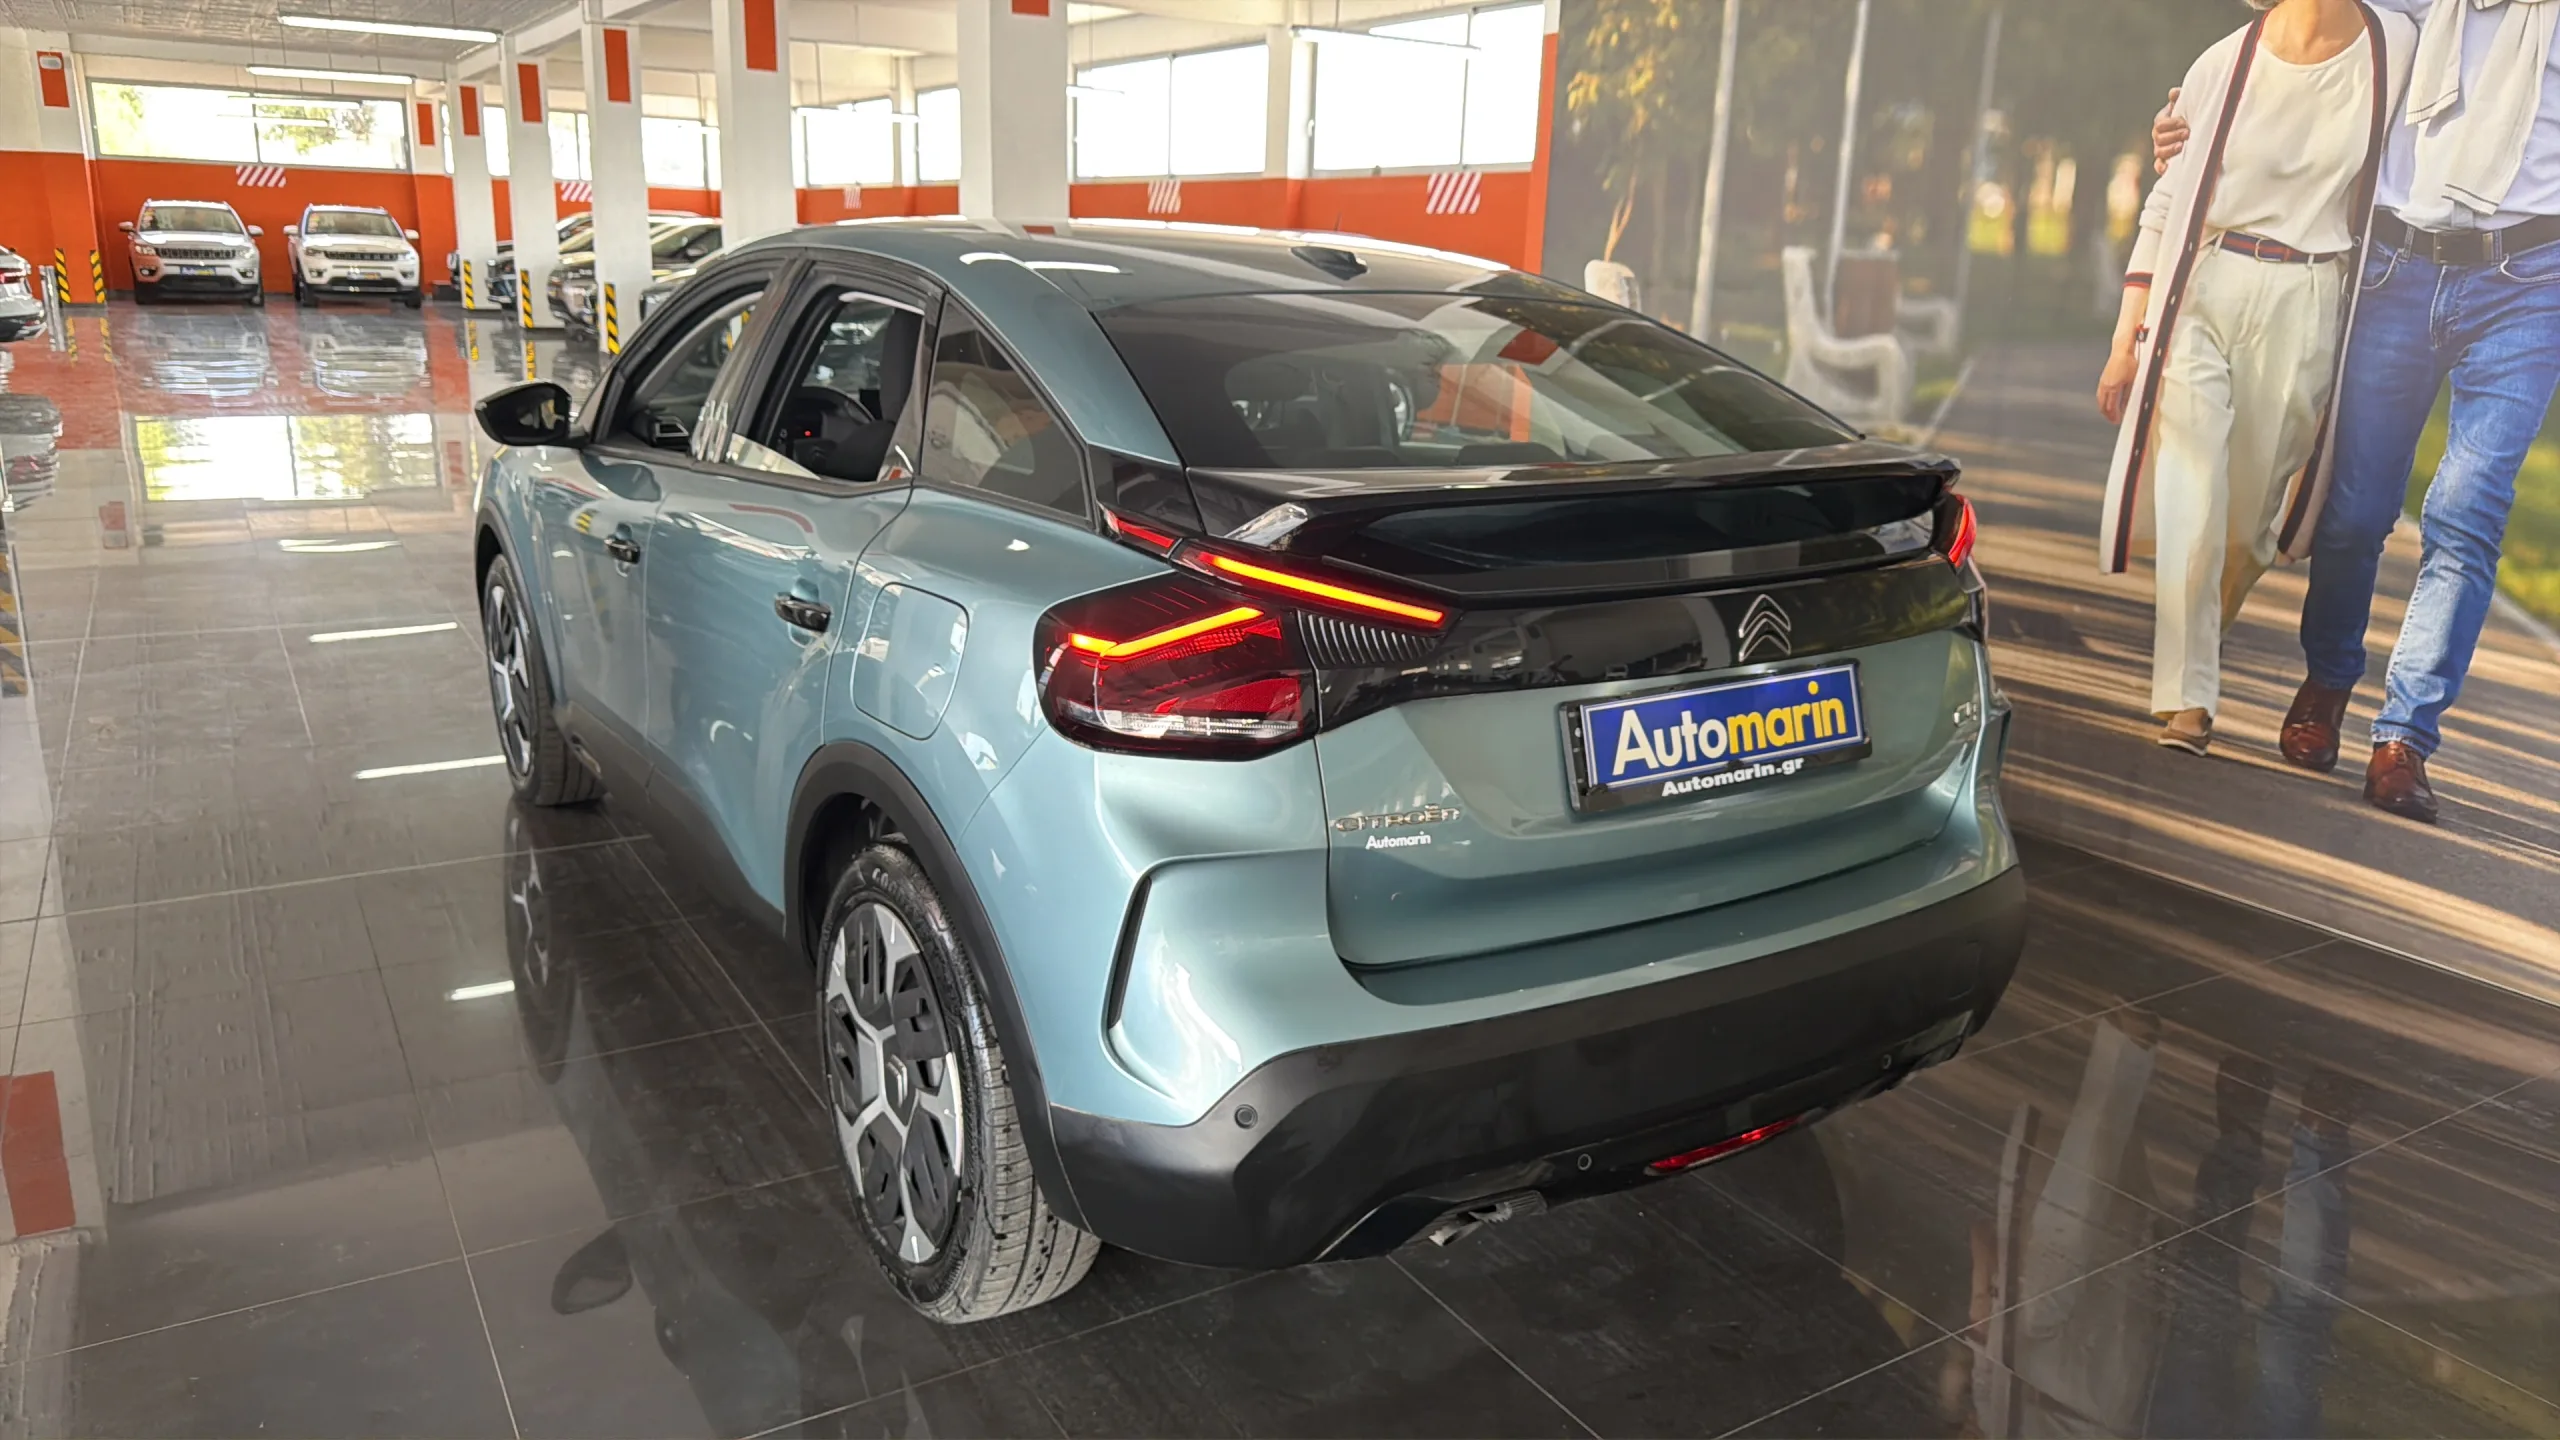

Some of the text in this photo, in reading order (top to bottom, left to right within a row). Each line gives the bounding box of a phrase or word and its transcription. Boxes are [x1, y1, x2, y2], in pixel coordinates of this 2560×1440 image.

[1612, 681, 1847, 776] Automarin
[1661, 757, 1804, 797] Automarin.gr
[1365, 831, 1432, 850] Automarin
